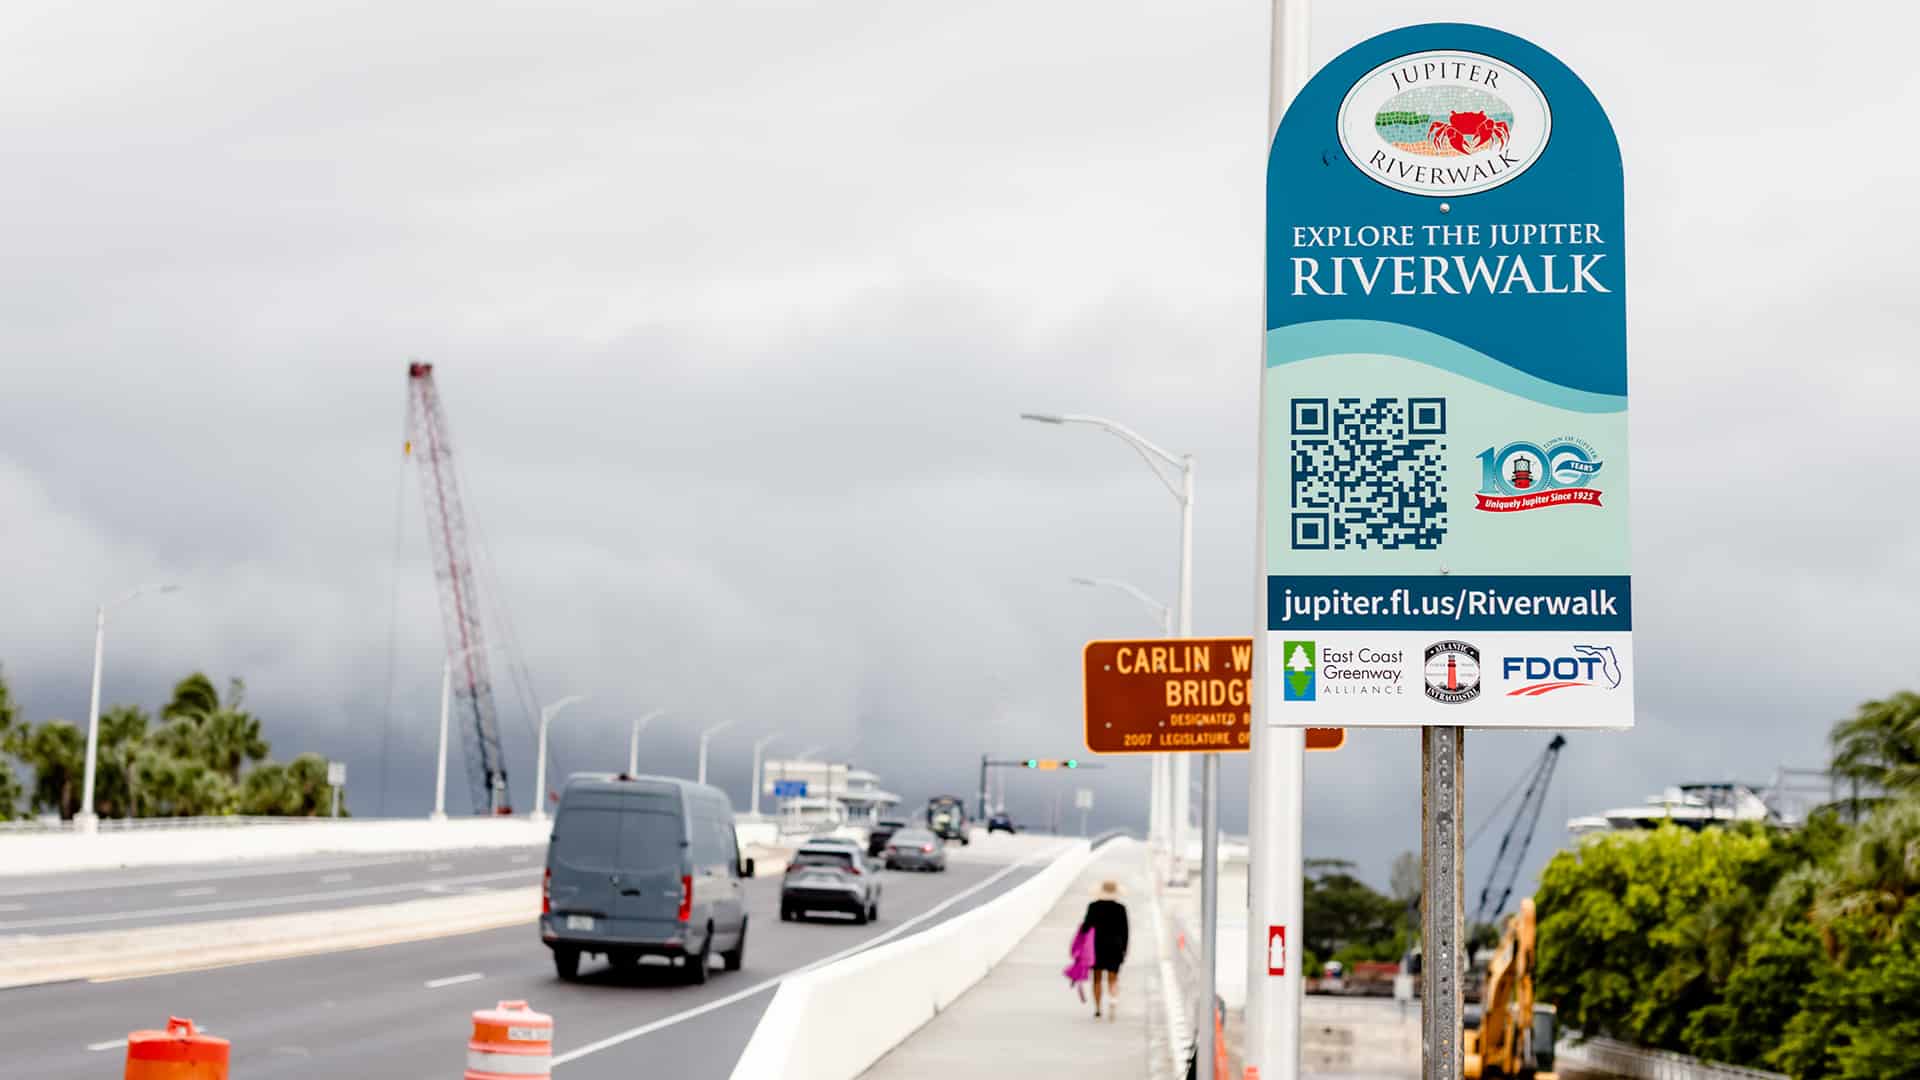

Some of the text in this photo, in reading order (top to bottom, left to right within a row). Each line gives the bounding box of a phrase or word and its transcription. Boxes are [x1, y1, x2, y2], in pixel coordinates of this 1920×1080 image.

[1391, 62, 1500, 91] JUPITER
[1369, 149, 1521, 185] RIVERWALK
[1292, 223, 1605, 248] EXPLORE THE JUPITER
[1289, 254, 1613, 296] RIVERWALK
[1485, 491, 1595, 510] Uniquely Jupiter Since 1925
[1282, 589, 1618, 621] jupiter.fl.us/Riverwalk
[1116, 646, 1210, 674] CARLIN
[1323, 647, 1403, 663] East Coast
[1323, 664, 1402, 684] Greenway
[1503, 657, 1602, 680] FDOT
[1323, 685, 1404, 695] ALLIANCE
[1170, 712, 1237, 726] DESIGNATED
[1123, 733, 1153, 747] 2007
[1160, 732, 1231, 746] LEGISLATURE
